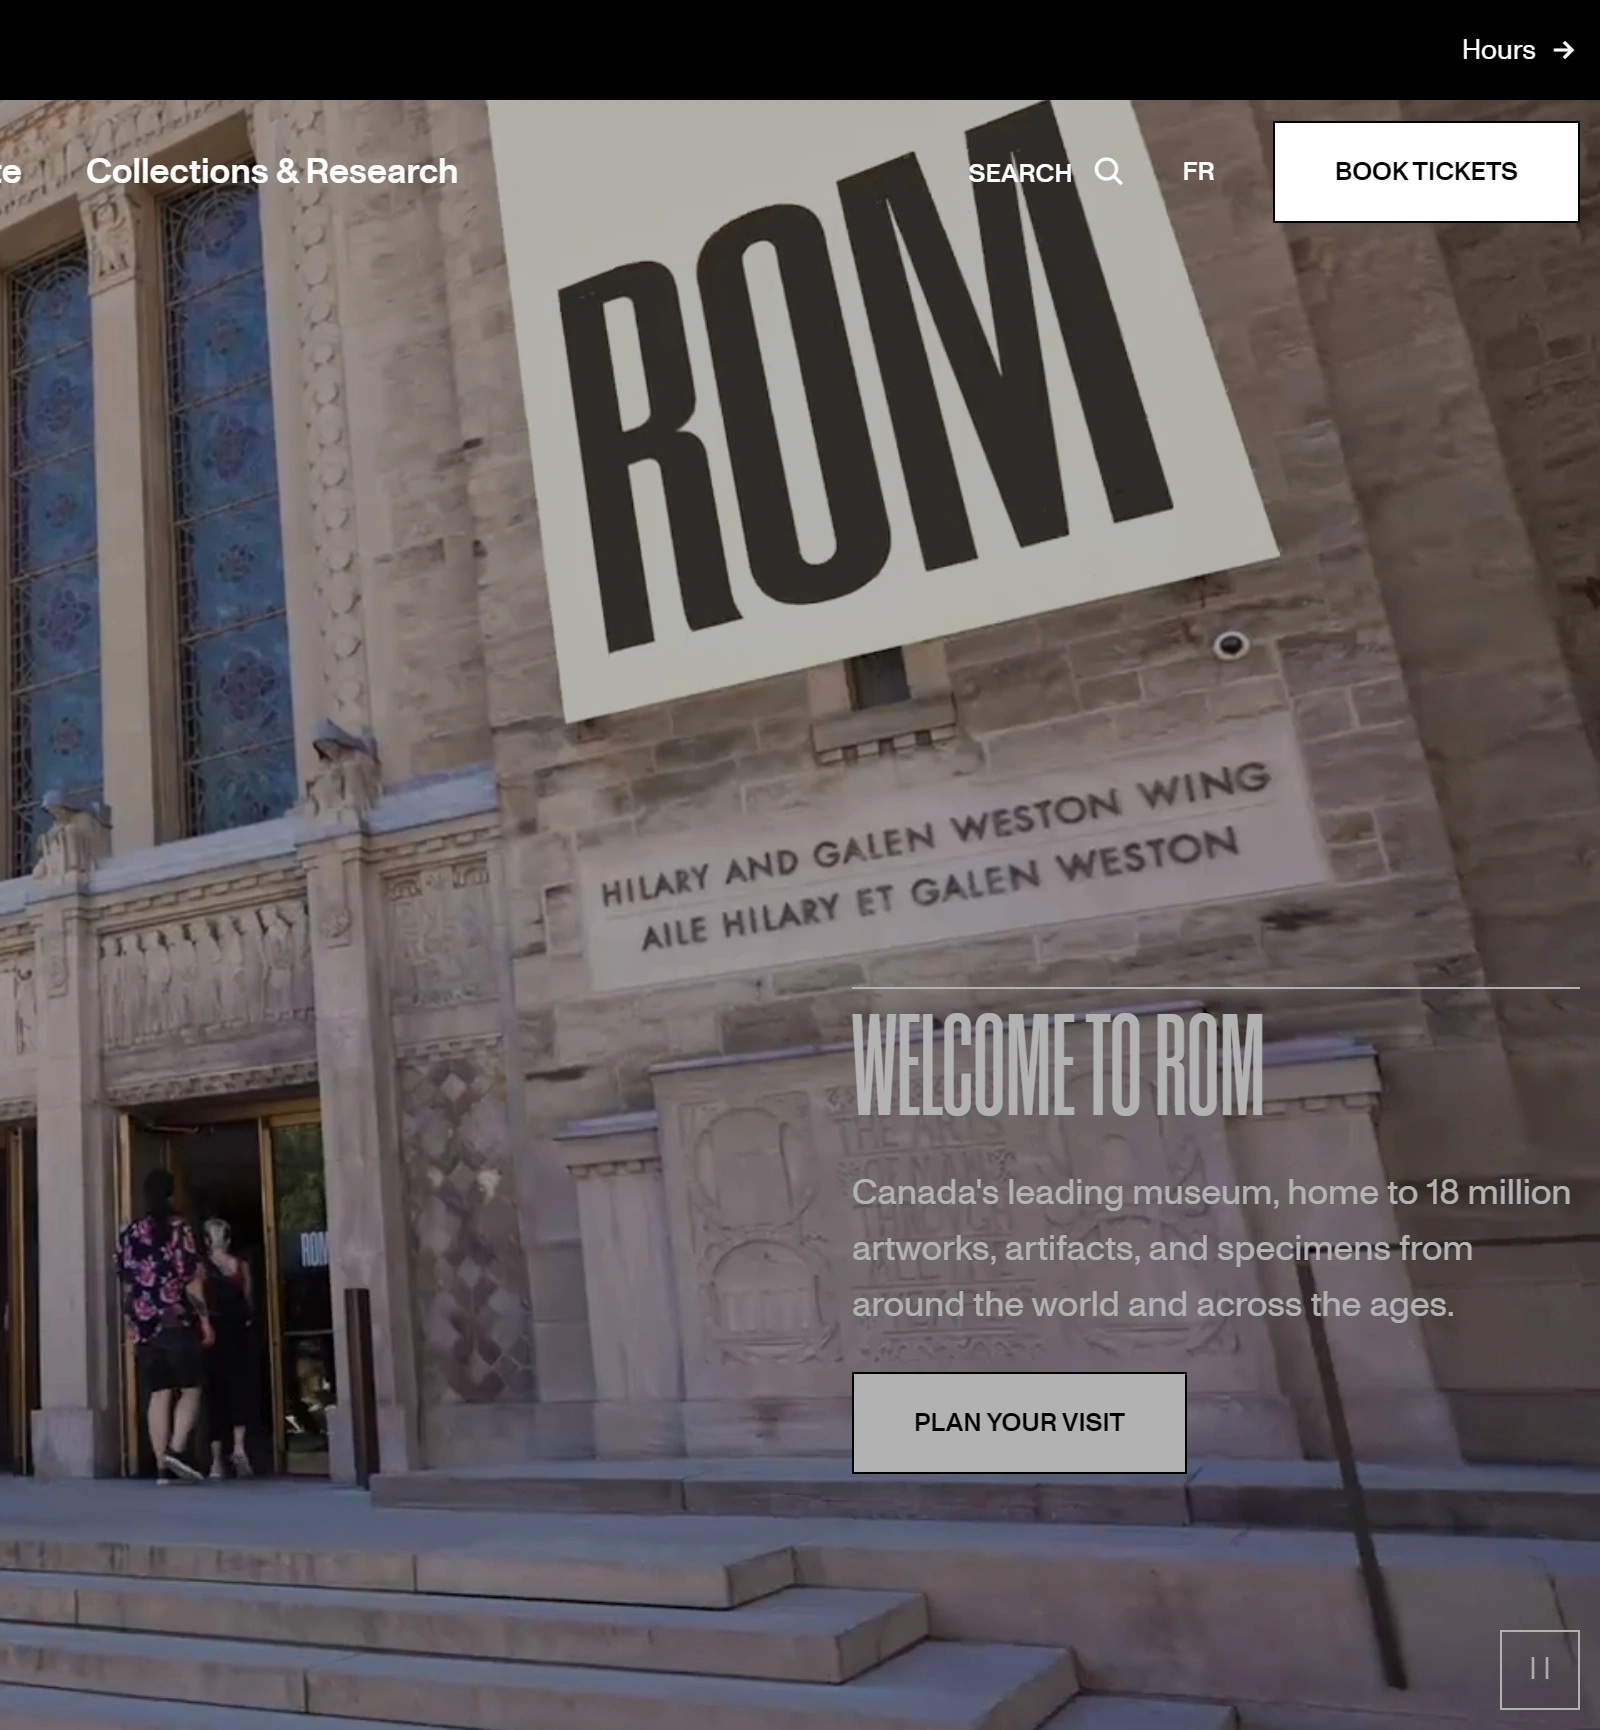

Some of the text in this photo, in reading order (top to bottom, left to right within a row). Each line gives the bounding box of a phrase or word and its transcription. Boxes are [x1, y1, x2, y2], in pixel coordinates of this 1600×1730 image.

[557, 100, 1175, 654] ROM
[602, 760, 1273, 908] HILARY AND GALEN WESTON WING
[641, 825, 1240, 952] AILE HILARY ET GALEN WESTON
[301, 1232, 329, 1266] ROM
